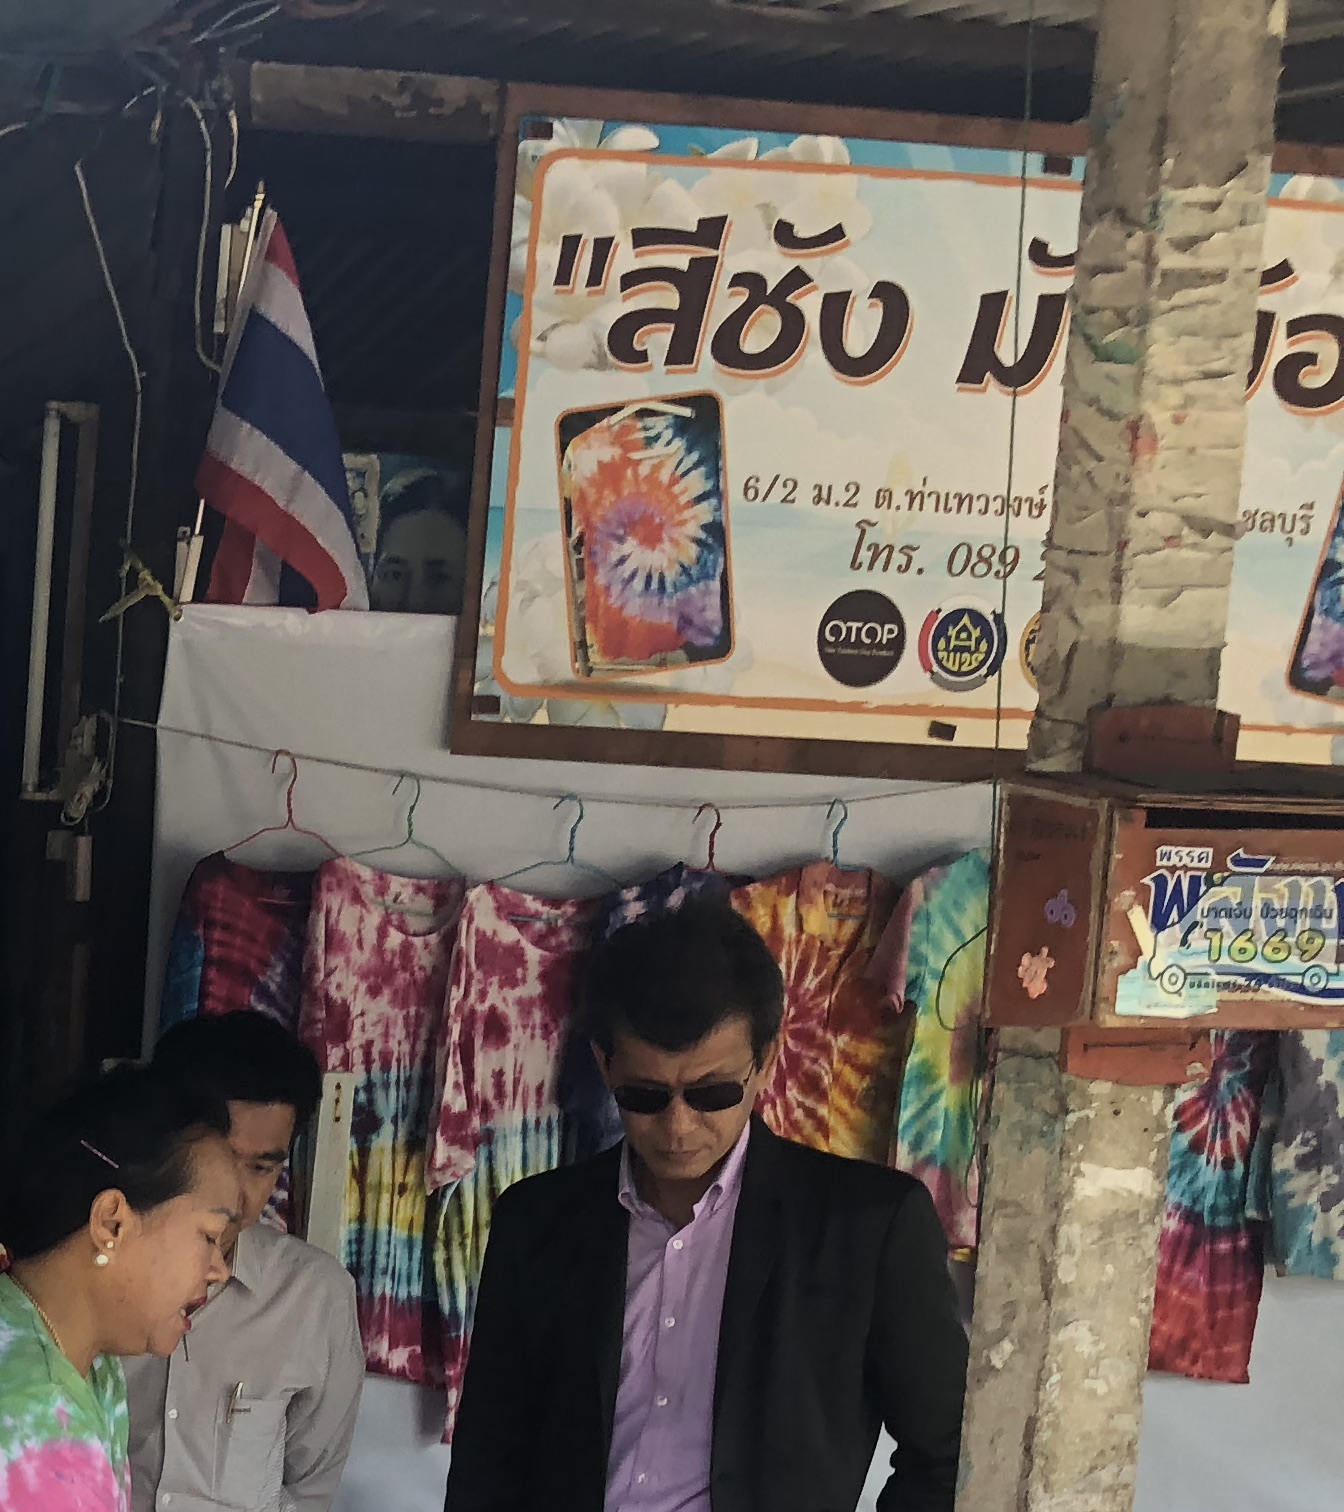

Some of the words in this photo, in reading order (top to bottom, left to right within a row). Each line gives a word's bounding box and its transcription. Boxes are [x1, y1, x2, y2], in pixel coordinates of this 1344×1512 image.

[742, 474, 798, 504] 6/2
[812, 481, 860, 509] ม.2
[849, 518, 925, 576] โทร.
[946, 541, 1021, 581] 089
[824, 619, 899, 645] OTOP
[1204, 928, 1326, 963] 1669
